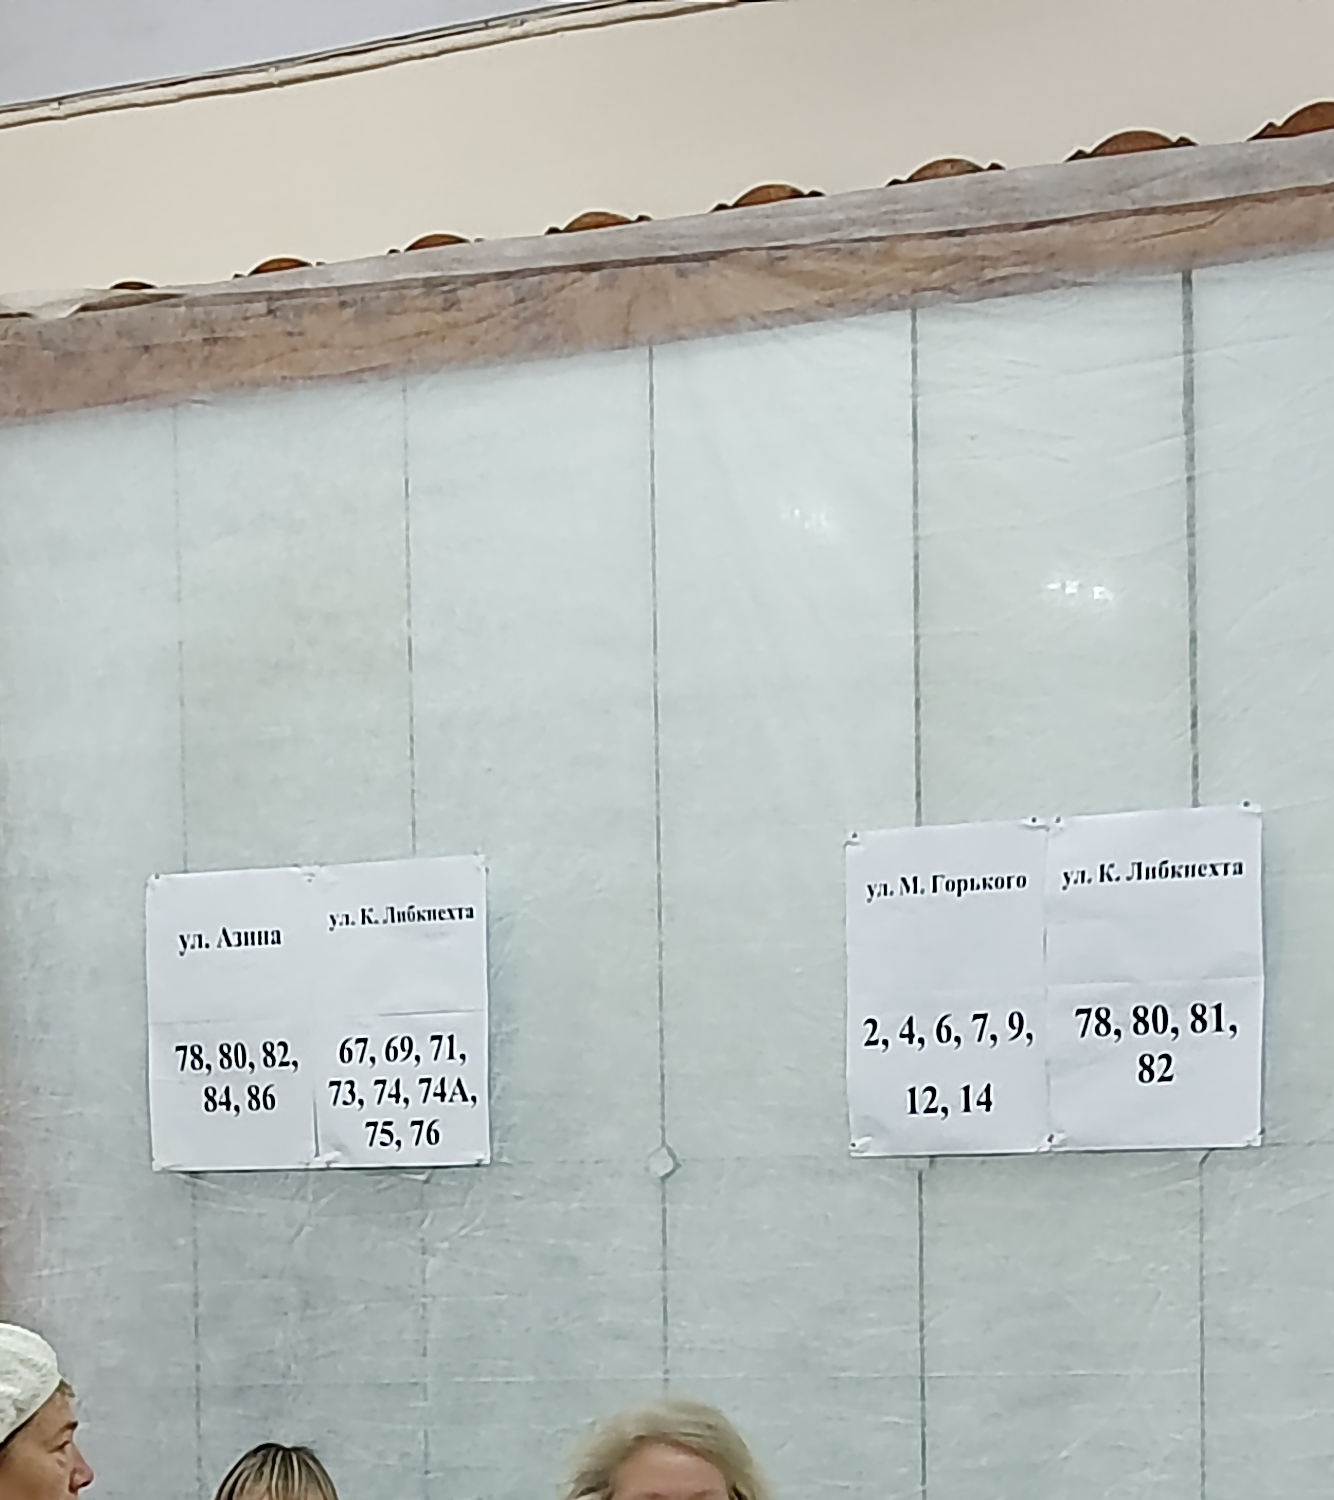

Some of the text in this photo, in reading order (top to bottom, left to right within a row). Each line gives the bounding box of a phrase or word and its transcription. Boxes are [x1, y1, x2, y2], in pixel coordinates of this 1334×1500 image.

[866, 873, 1027, 904] ул. М. Горького
[1061, 859, 1244, 891] ул. К. Либкнехта
[328, 904, 475, 932] ул. К. Либкнехта
[178, 926, 282, 957] ул. Азина
[863, 1010, 1034, 1053] 2, 4, 6, 7, 9,
[1074, 1002, 1238, 1044] 78, 80, 81,
[174, 1040, 299, 1077] 78, 80, 82,
[339, 1034, 467, 1068] 67, 69, 71,
[1138, 1053, 1175, 1084] 82
[203, 1083, 276, 1118] 84, 86
[328, 1076, 477, 1111] 73, 74, 74А,
[907, 1082, 993, 1121] 12, 14
[364, 1118, 440, 1152] 75, 76
